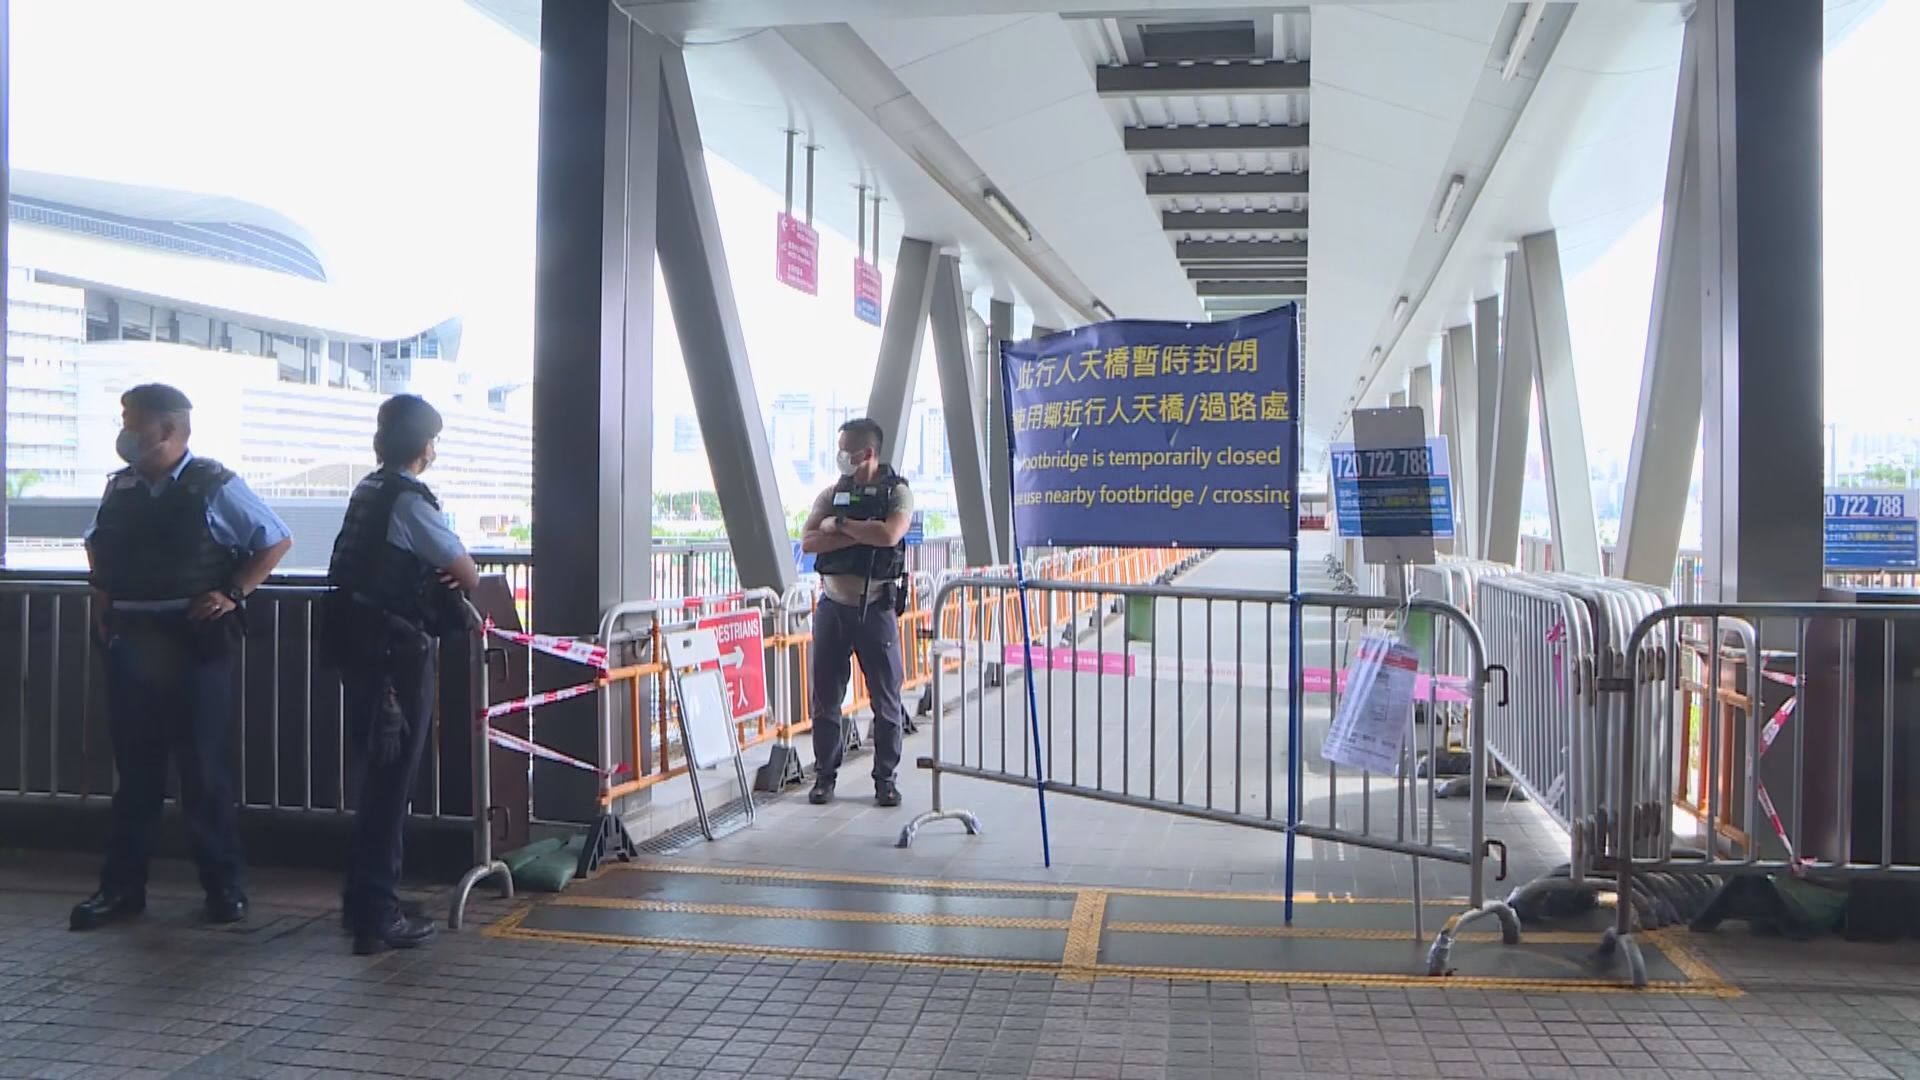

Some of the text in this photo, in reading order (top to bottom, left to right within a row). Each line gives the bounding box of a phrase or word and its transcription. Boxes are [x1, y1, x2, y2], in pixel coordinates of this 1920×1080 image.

[1017, 338, 1258, 390] 此行人天橋暫時封閉
[1093, 448, 1105, 466] is
[1109, 446, 1211, 471] temporarily
[1217, 446, 1281, 466] closed
[1334, 450, 1431, 477] 720 722 788
[1023, 491, 1042, 505] use
[1045, 485, 1095, 508] nearby
[1100, 484, 1193, 510] footbridge
[1198, 486, 1207, 505] /
[1840, 495, 1869, 516] 722
[1872, 495, 1902, 517] 788
[713, 618, 760, 643] DESTRIANS
